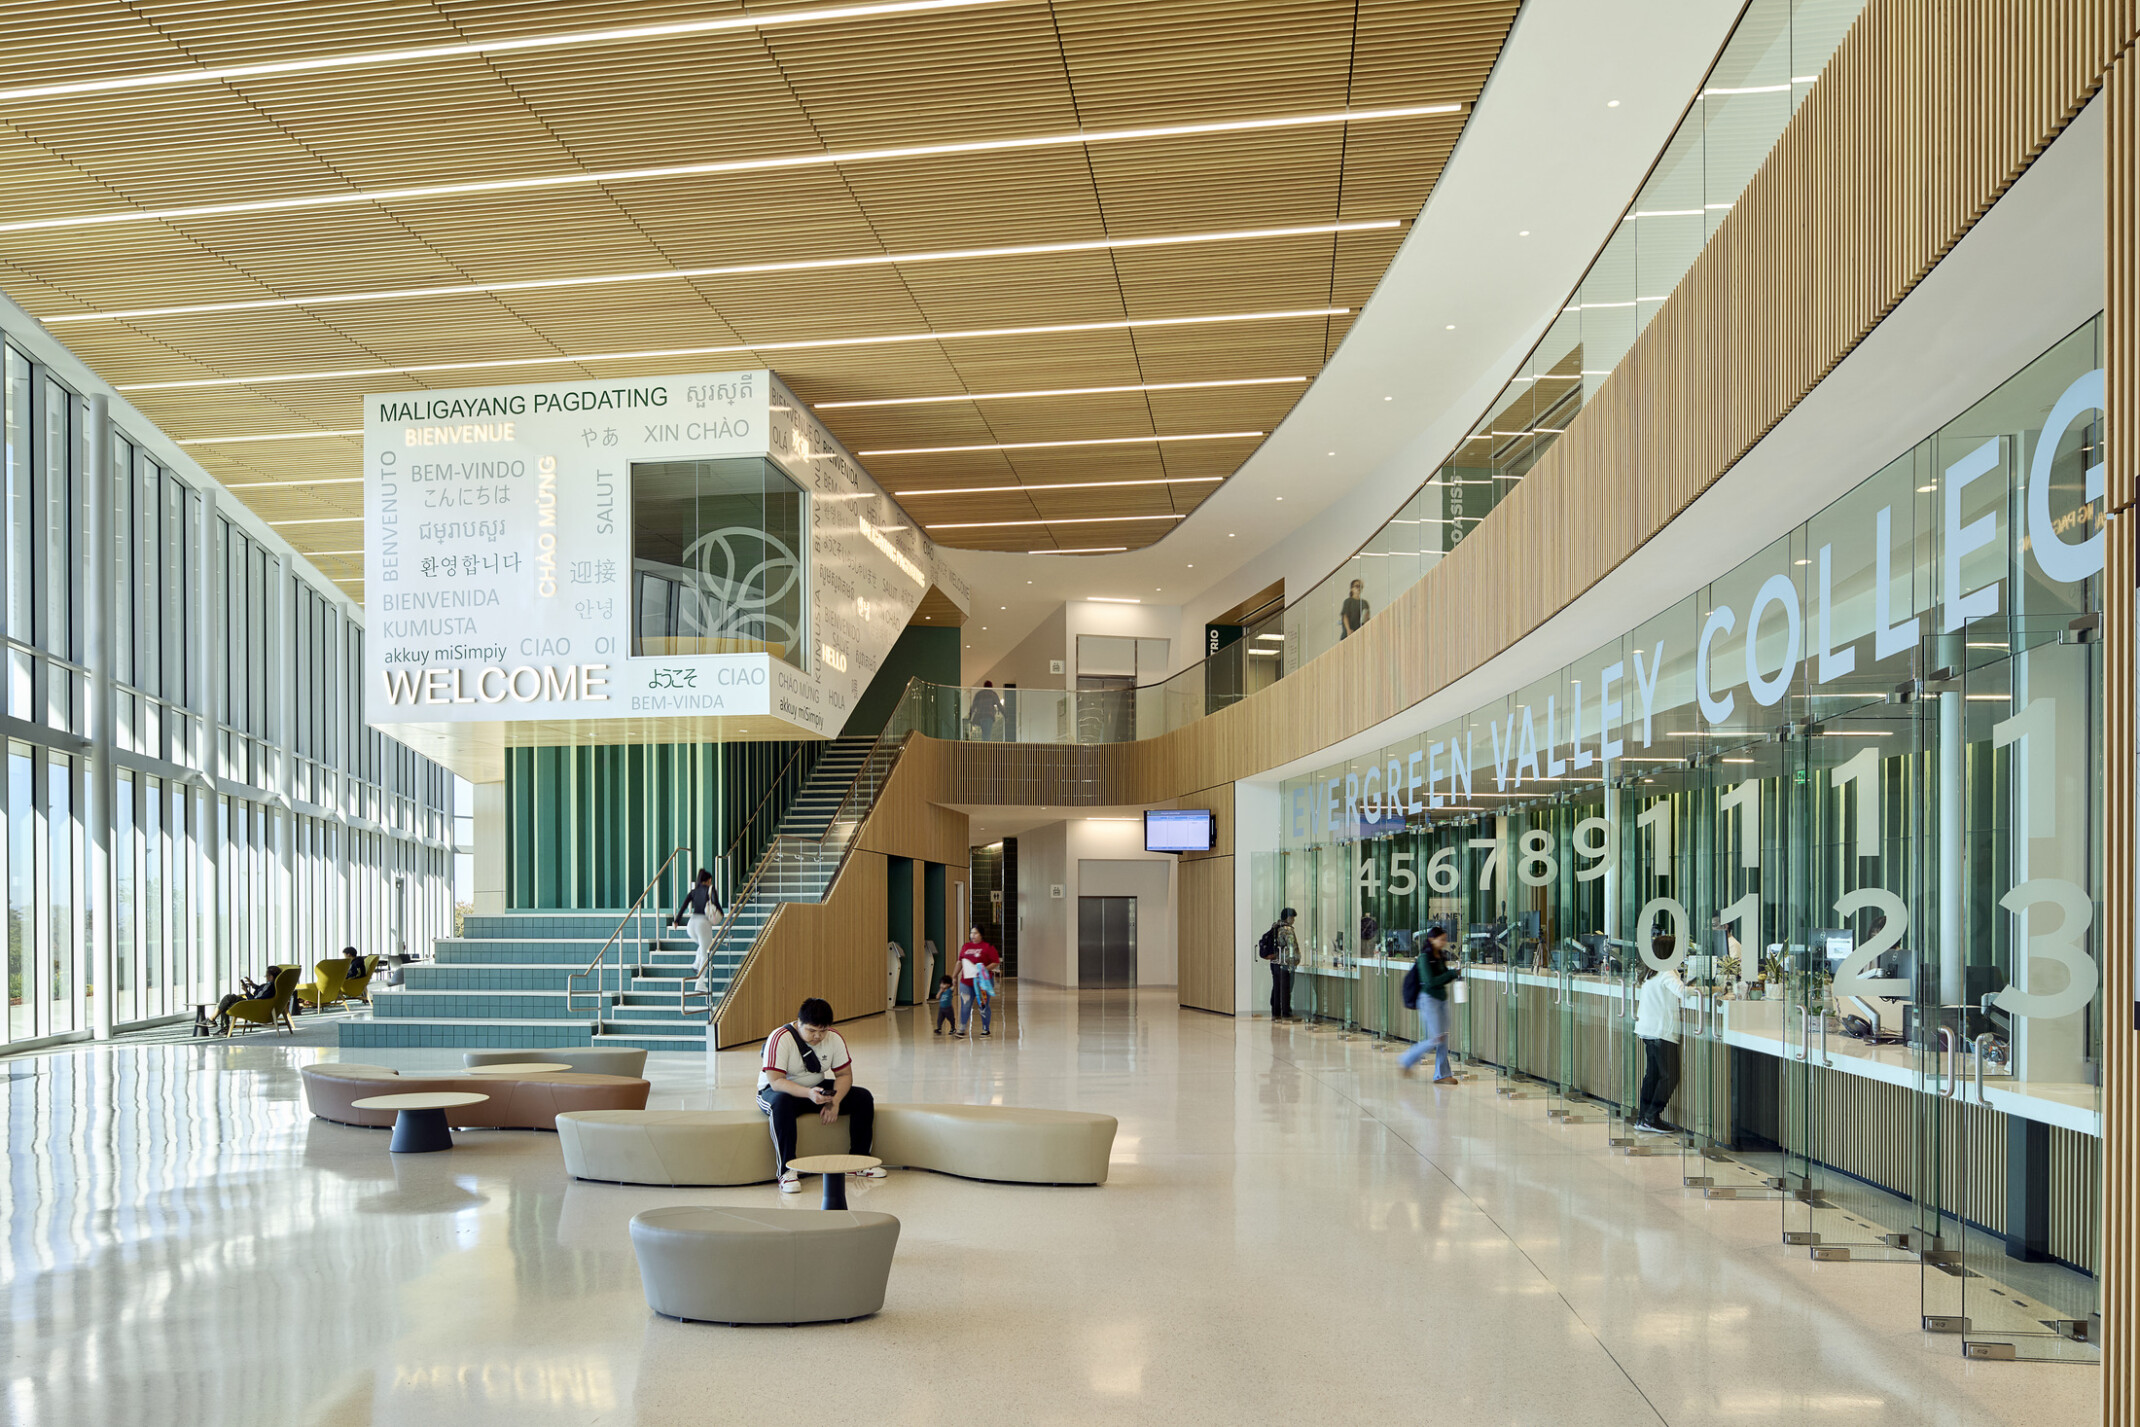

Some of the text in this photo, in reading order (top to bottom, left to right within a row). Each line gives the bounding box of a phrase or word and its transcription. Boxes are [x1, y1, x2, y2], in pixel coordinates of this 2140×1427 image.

[380, 387, 667, 422] MALIGAYANG PAGDATING
[405, 421, 516, 447] BIENVENUE
[581, 427, 619, 448] やあ
[644, 416, 749, 443] XIN CHÀO
[772, 425, 788, 454] OLÁ
[411, 460, 525, 482] BEM-VINDO
[424, 484, 511, 508] こんにちは
[597, 469, 614, 534] SALUT
[381, 451, 399, 582] BENVENUTO
[420, 551, 522, 578] 환영합니다
[536, 533, 558, 598] CHÀO
[570, 558, 617, 584] 迎接
[383, 588, 500, 611] BIENVENIDA
[574, 597, 614, 620] 안녕
[383, 616, 478, 638] KUMUSTA
[384, 643, 507, 665] akkuy miSimpiy
[520, 637, 571, 657] CIAO
[595, 636, 615, 654] OI
[1210, 629, 1219, 656] TRIO
[821, 642, 848, 673] HELLO
[382, 663, 611, 705] WELCOME
[648, 667, 697, 689] ようこそ
[717, 667, 766, 686] CIAO
[631, 694, 724, 710] BEM-VINDA
[828, 689, 846, 711] HOLA
[1293, 731, 1473, 838] EVERGREEN
[1491, 640, 1664, 792] VALLEY
[1357, 858, 1381, 897] 4
[1388, 853, 1416, 895] 5
[1427, 846, 1460, 893] 6
[1468, 839, 1505, 890] 7
[1517, 829, 1558, 887] 8
[1572, 817, 1617, 882] 9
[1433, 912, 1465, 920] MNEY
